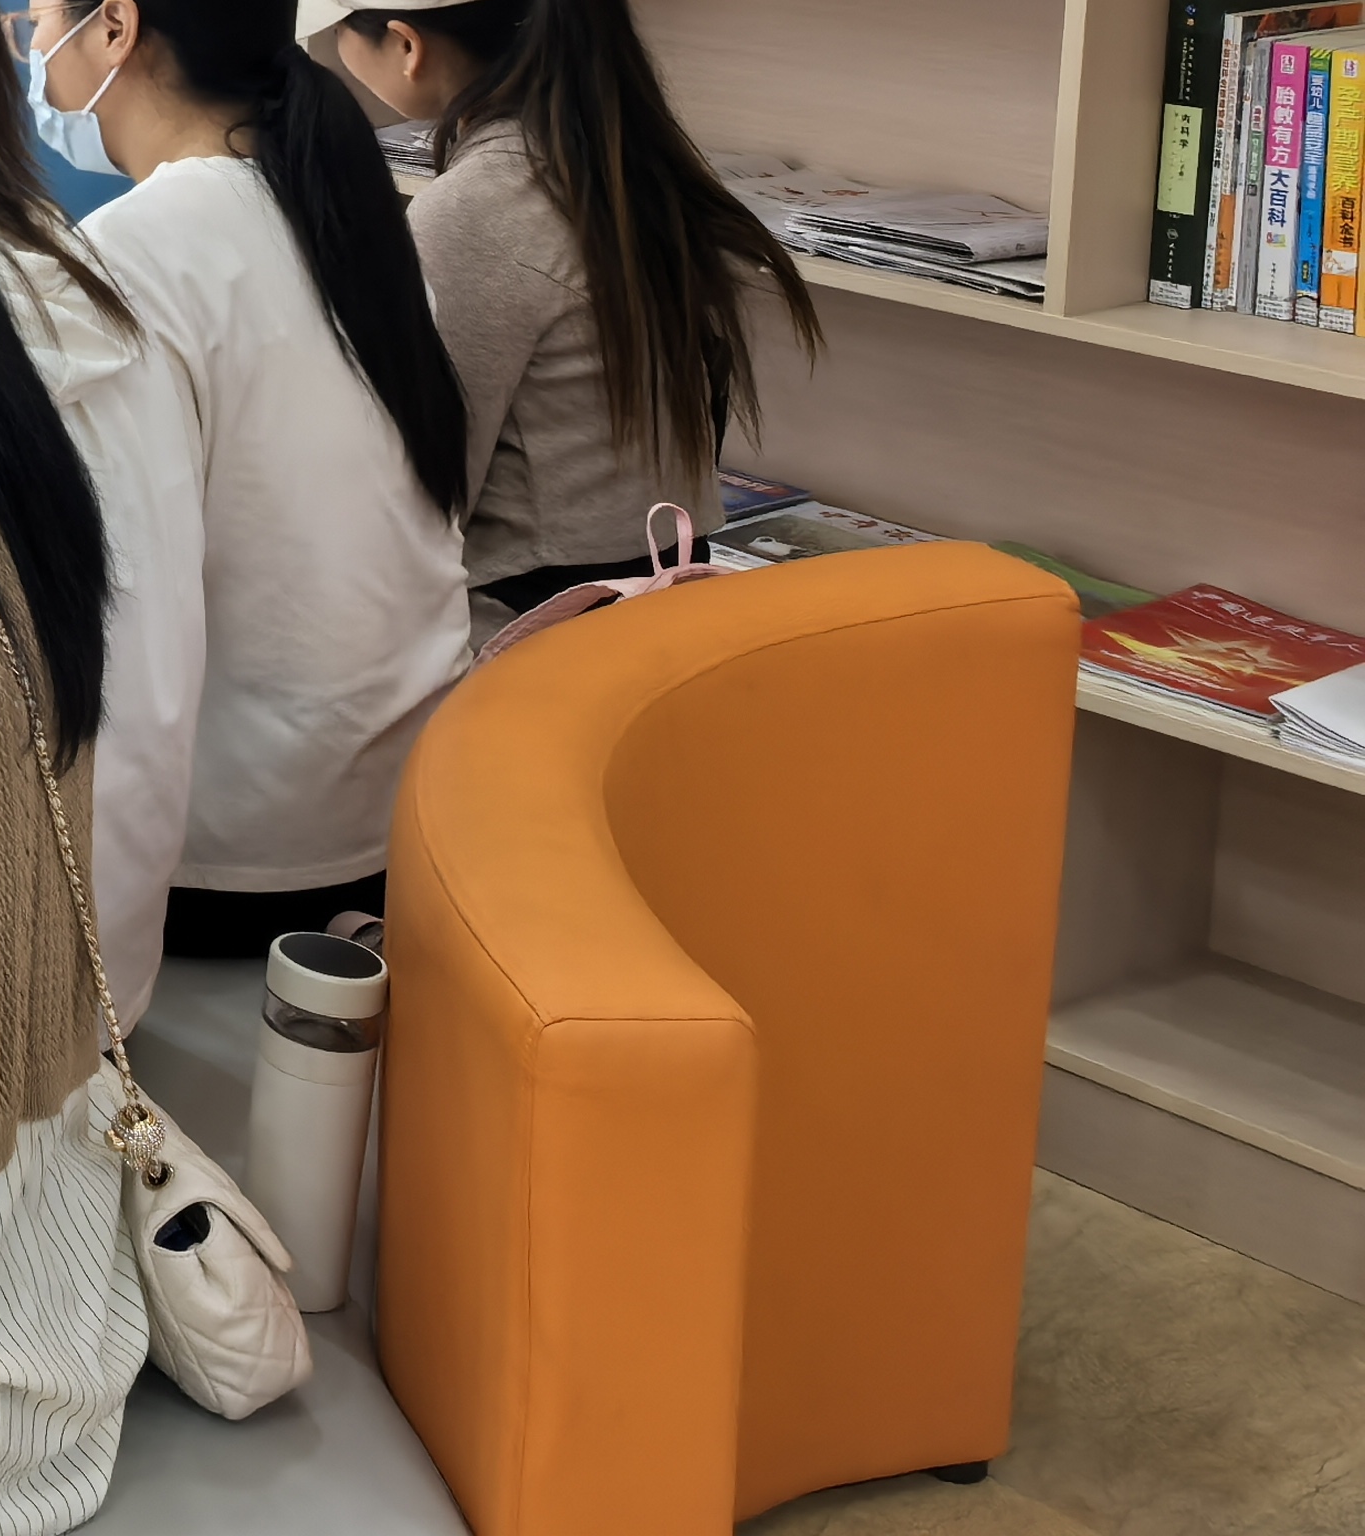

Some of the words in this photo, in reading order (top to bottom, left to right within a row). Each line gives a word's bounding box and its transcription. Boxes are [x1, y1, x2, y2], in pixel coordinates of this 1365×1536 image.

[1270, 86, 1296, 165] 胎教有方
[1267, 169, 1291, 228] 大百科
